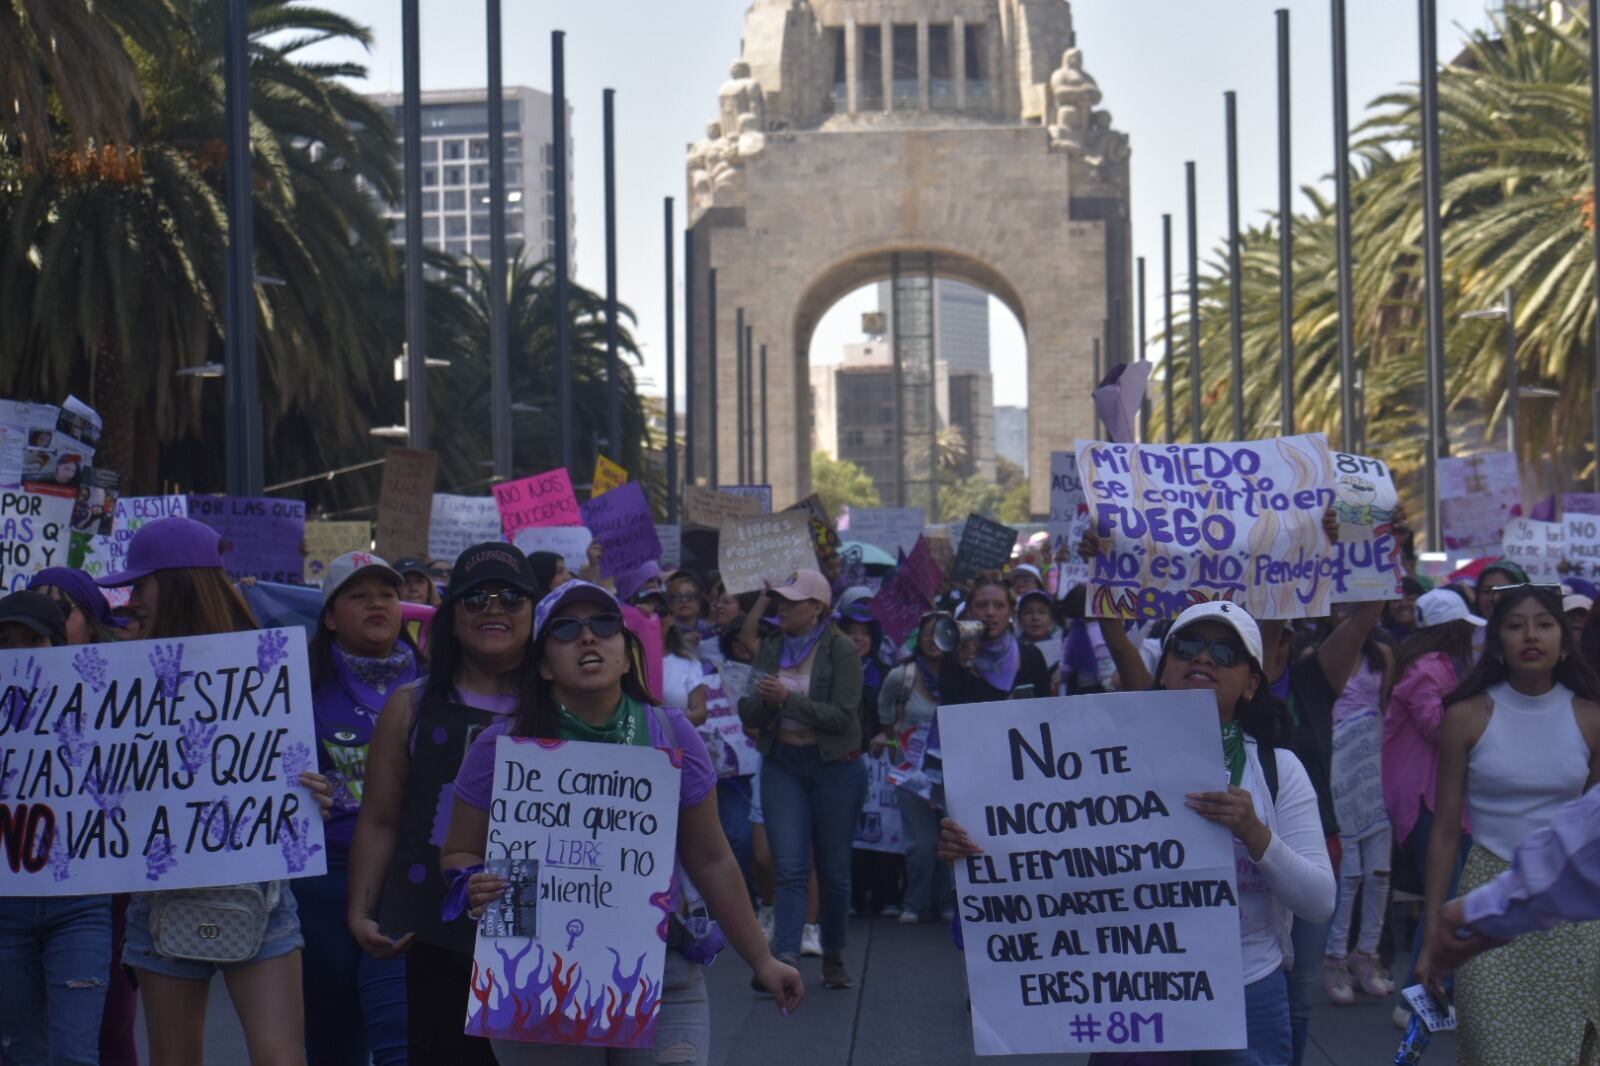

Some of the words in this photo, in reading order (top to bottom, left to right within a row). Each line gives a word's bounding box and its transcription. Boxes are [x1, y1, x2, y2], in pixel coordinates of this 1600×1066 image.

[1092, 446, 1129, 474] Mi
[1336, 453, 1384, 476] 8M
[2, 493, 41, 516] POR
[134, 496, 182, 517] BESTIA
[498, 486, 520, 504] NO
[528, 476, 564, 497] NOS
[1092, 480, 1129, 499] se
[1293, 488, 1335, 511] en
[189, 502, 223, 516] POR
[232, 502, 266, 516] LAS
[272, 503, 303, 518] QUE
[1096, 503, 1235, 550] FUEGO
[1151, 554, 1186, 581] es
[34, 683, 83, 735] LA
[95, 665, 291, 730] MAESTRA
[16, 745, 73, 800] LAS
[79, 732, 195, 795] NIÑAS
[212, 727, 288, 786] QUE
[503, 760, 543, 793] De
[1091, 745, 1132, 775] TE
[66, 807, 129, 860] VAS
[143, 805, 172, 857] A
[185, 793, 300, 854] TOCAR
[490, 798, 507, 823] a
[514, 798, 570, 828] casa
[583, 805, 658, 840] quiero
[985, 790, 1170, 836] INCOMODA
[620, 847, 655, 877] no
[966, 854, 1008, 884] EL
[1009, 838, 1186, 883] FEMINISMO
[963, 895, 1033, 923] SINO
[1038, 888, 1130, 918] DARTE
[1134, 879, 1238, 909] CUENTA
[986, 932, 1043, 963] QUE
[1051, 929, 1090, 958] AL
[1096, 921, 1187, 955] FINAL
[1020, 971, 1090, 1006] ERES
[1092, 969, 1215, 1004] MACHISTA
[1069, 1011, 1164, 1044] #8M
